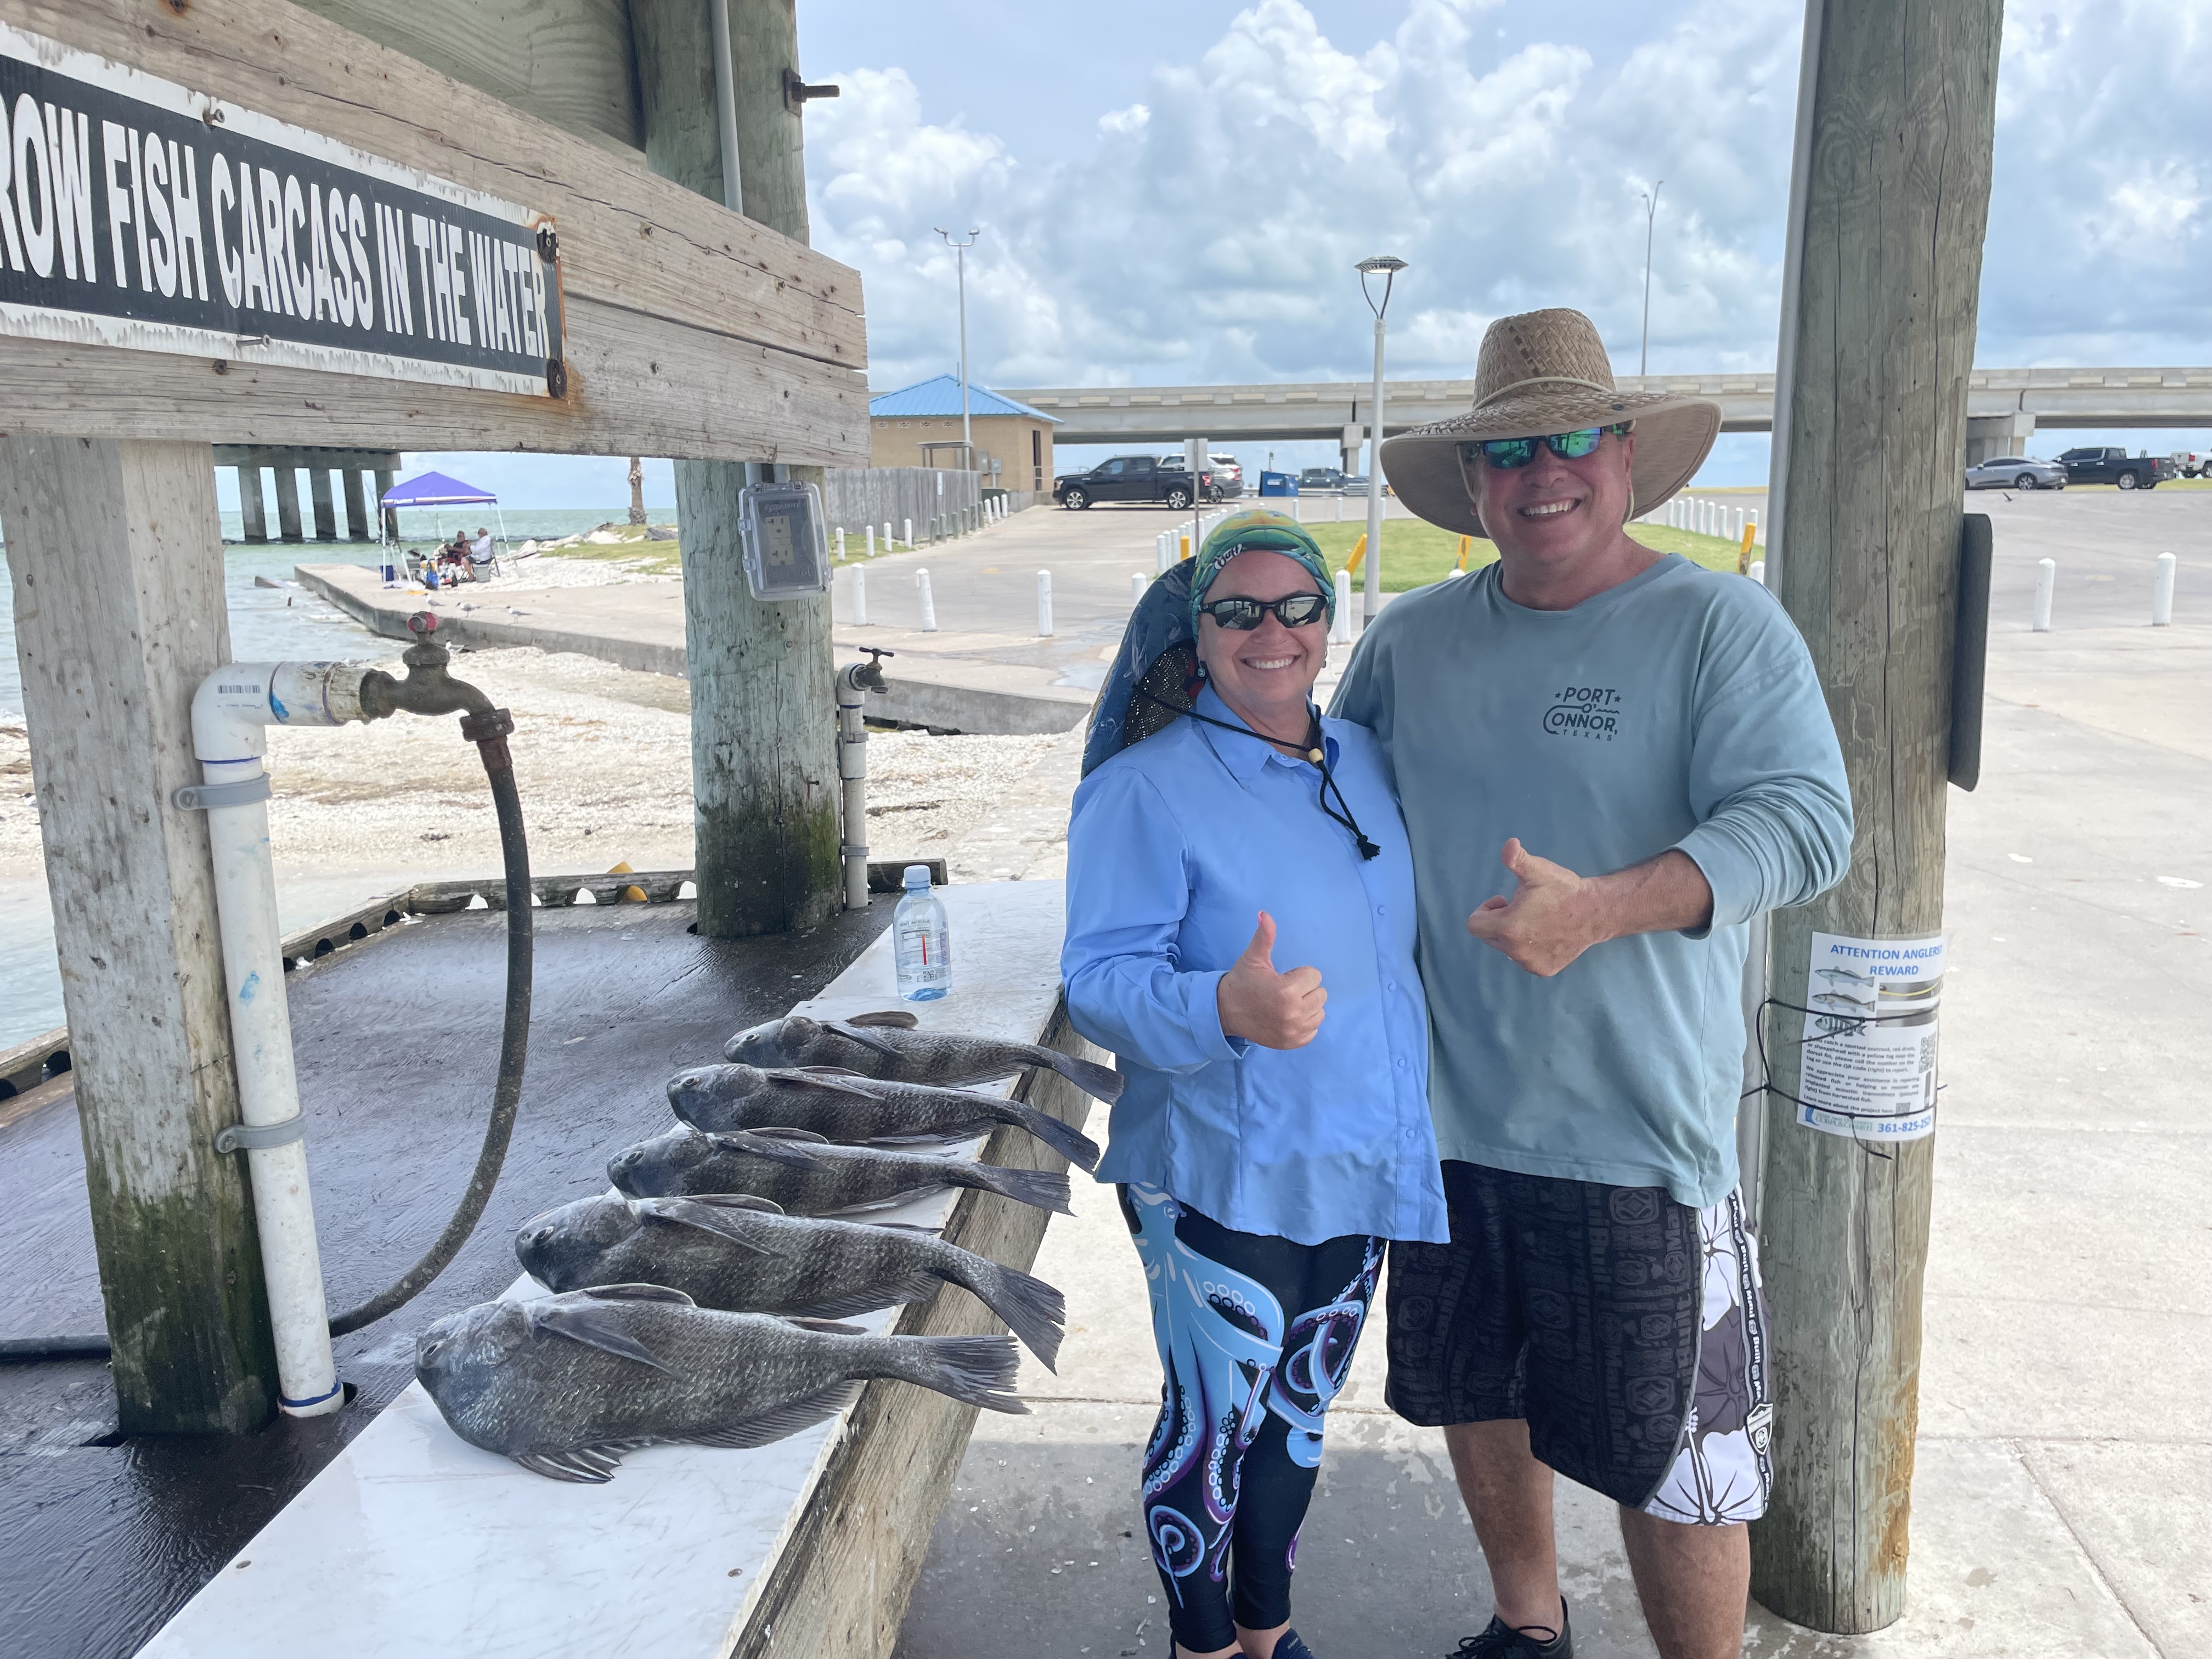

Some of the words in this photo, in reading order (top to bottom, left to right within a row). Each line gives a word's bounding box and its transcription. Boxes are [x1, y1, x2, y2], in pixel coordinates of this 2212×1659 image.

[102, 120, 208, 302] FISH
[211, 152, 373, 331] CARCASS
[375, 202, 414, 336] IN
[411, 213, 471, 346] THE
[469, 230, 550, 359] WATER
[1562, 687, 1616, 706] PORT
[1563, 729, 1612, 741] TEXAS
[1831, 944, 1899, 960] ATTENTION
[1870, 965, 1918, 975] REWARD
